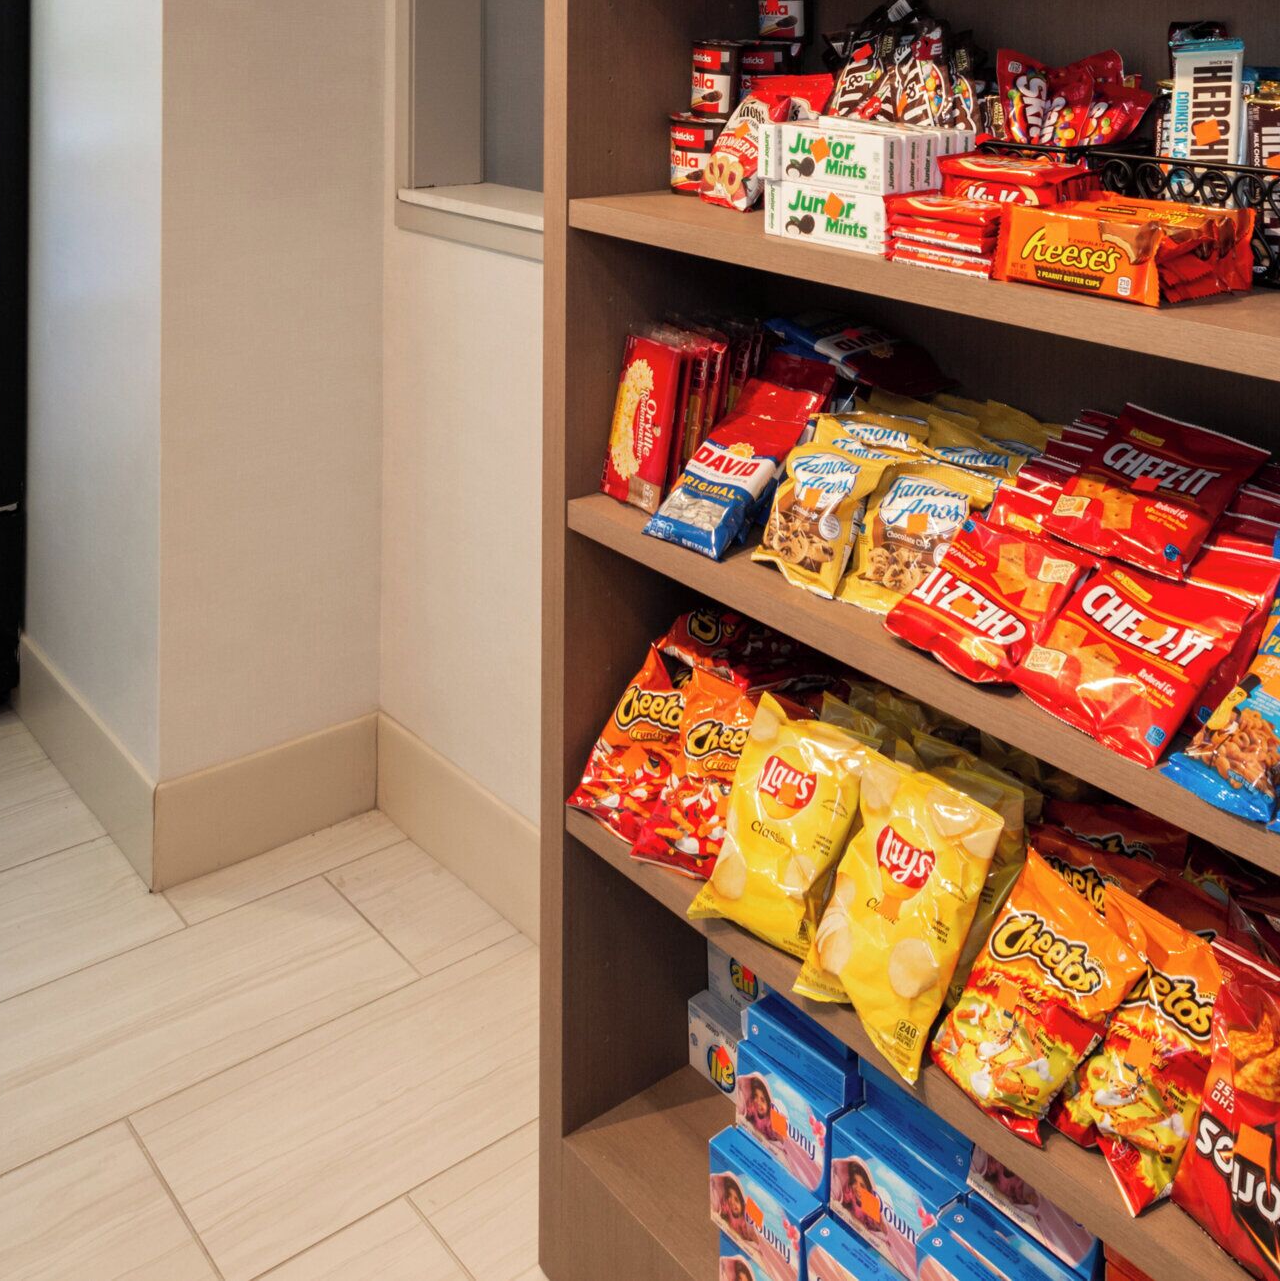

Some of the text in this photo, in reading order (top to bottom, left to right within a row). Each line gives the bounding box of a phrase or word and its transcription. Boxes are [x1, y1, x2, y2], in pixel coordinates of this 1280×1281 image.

[1174, 91, 1189, 134] COOKIES
[789, 133, 854, 160] Juior
[825, 159, 866, 179] Mints
[825, 218, 867, 239] Mints
[1022, 227, 1121, 273] Reese's
[1043, 271, 1101, 288] PEANUT BUTTER CUPS
[1119, 277, 1130, 286] 210
[643, 398, 657, 457] Orville
[693, 447, 760, 477] DAVID
[793, 453, 860, 476] Famous
[1104, 442, 1222, 498] CHEEZ-IT
[802, 477, 851, 494] Amos
[888, 475, 969, 505] Famous
[890, 500, 966, 523] Amos
[1155, 502, 1176, 515] Reduced
[887, 531, 930, 548] Chocolate Chip
[1138, 669, 1162, 689] Reduced
[629, 728, 671, 743] Crunchy
[879, 827, 934, 884] Lay's
[992, 915, 1100, 992] Cheetos
[898, 1022, 917, 1037] 240
